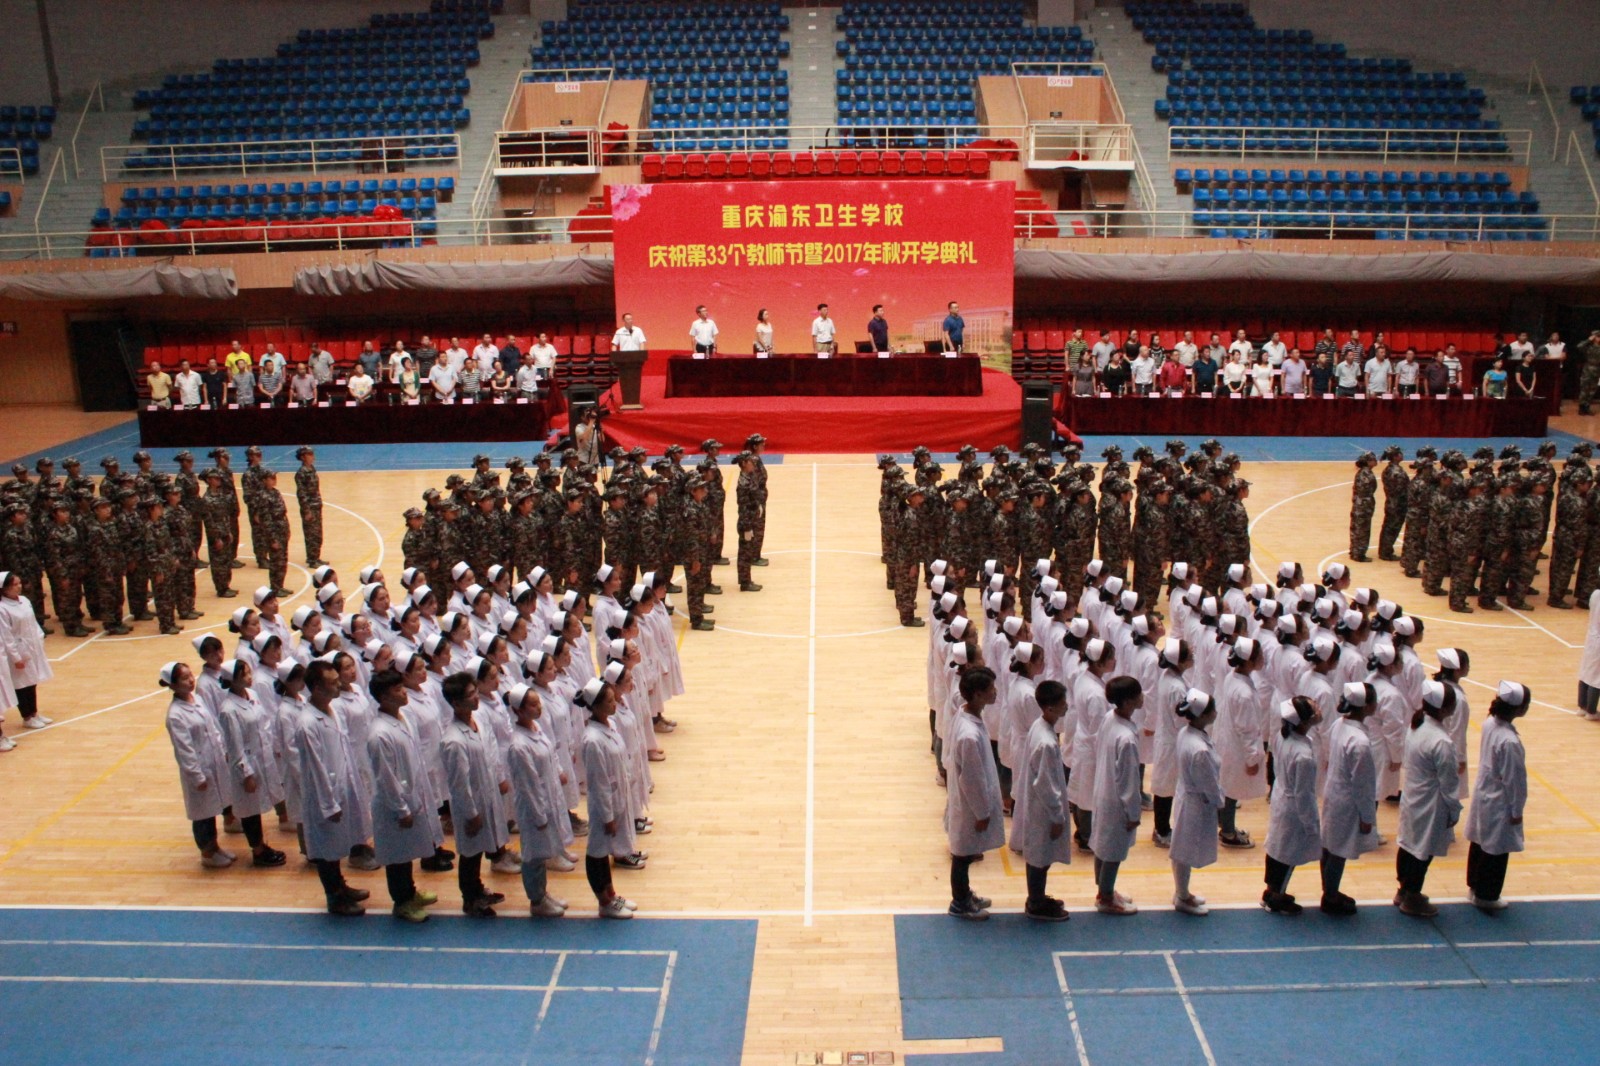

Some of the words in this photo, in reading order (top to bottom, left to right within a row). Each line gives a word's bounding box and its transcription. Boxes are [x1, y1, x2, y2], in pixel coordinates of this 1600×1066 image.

[722, 203, 903, 228] 重庆渝东卫生学校
[649, 241, 978, 268] 庆祝第33个教师节暨2017年秋开学典礼
